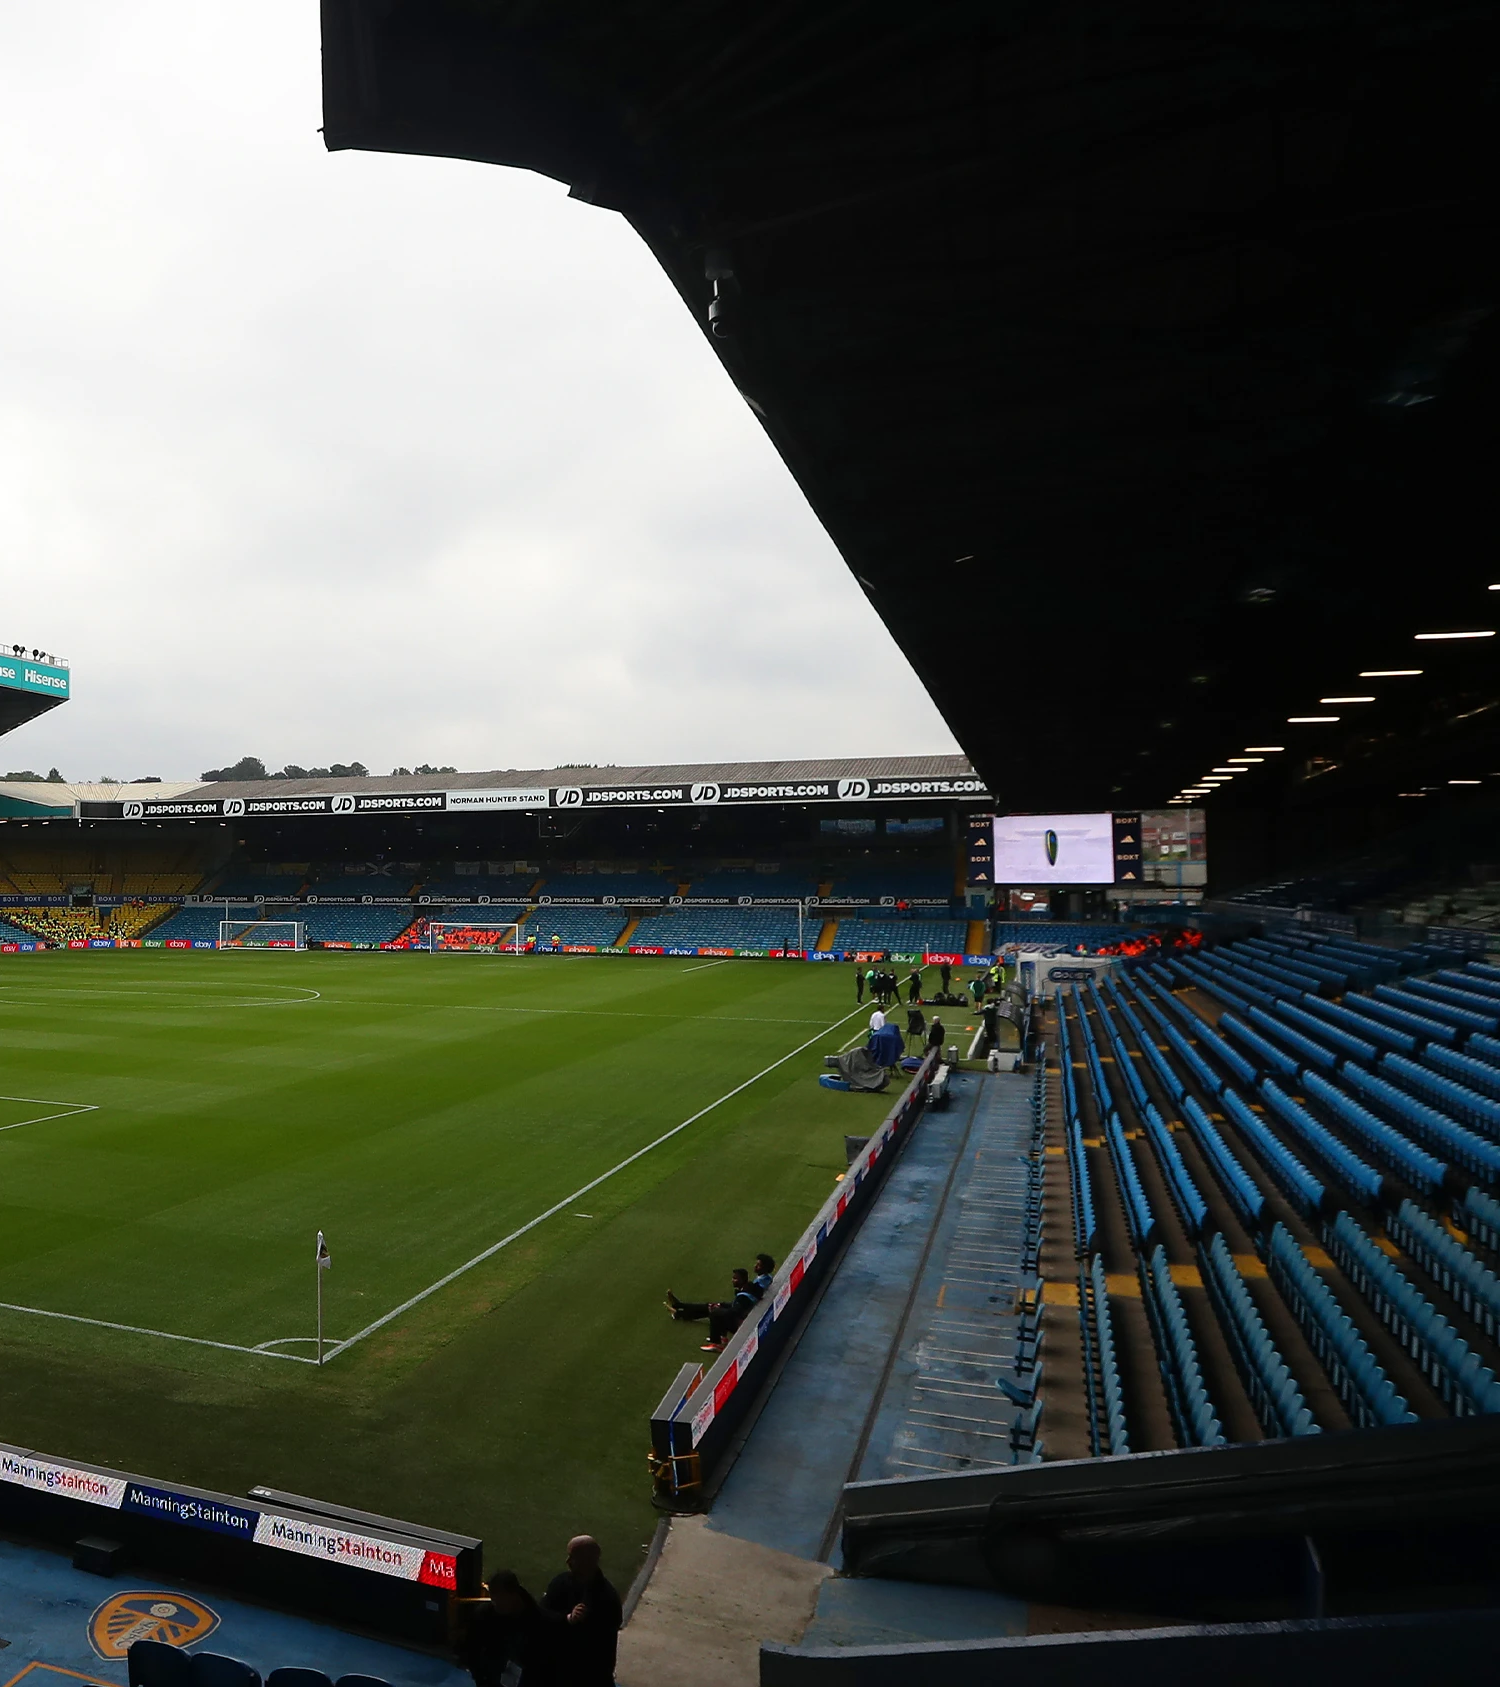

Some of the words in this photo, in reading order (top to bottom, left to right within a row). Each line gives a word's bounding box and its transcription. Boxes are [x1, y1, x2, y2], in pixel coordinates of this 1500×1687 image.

[24, 668, 67, 690] Hisense
[450, 796, 483, 806] NORMAN
[485, 795, 518, 805] HUNTER
[519, 794, 546, 804] STAND
[586, 788, 683, 803] JDSPORTS.COM
[724, 784, 829, 798] JDSPORTS.COM
[873, 779, 988, 795] JDSPORTS.COM
[144, 802, 217, 816] JDSPORTS.COM
[247, 799, 326, 814] JDSPORTS.COM
[357, 795, 442, 809] JDSPORTS.COM
[1115, 817, 1139, 825] BOXT
[1117, 853, 1140, 861] BOXT
[4, 944, 16, 953] ebay
[21, 943, 34, 951] ebay
[71, 940, 85, 949] ebay
[93, 939, 111, 948] ebay
[146, 940, 162, 949] ebay
[169, 940, 187, 949] ebay
[194, 940, 211, 949] ebay
[635, 947, 658, 955] ebay
[704, 948, 727, 956] ebay
[740, 949, 763, 957] ebay
[929, 954, 955, 965] ebay
[968, 955, 991, 966] ebay
[1, 1455, 108, 1497] ManningStainton
[130, 1488, 249, 1531] ManningStainton
[272, 1522, 403, 1567] ManningStainton
[429, 1558, 455, 1579] Ma
